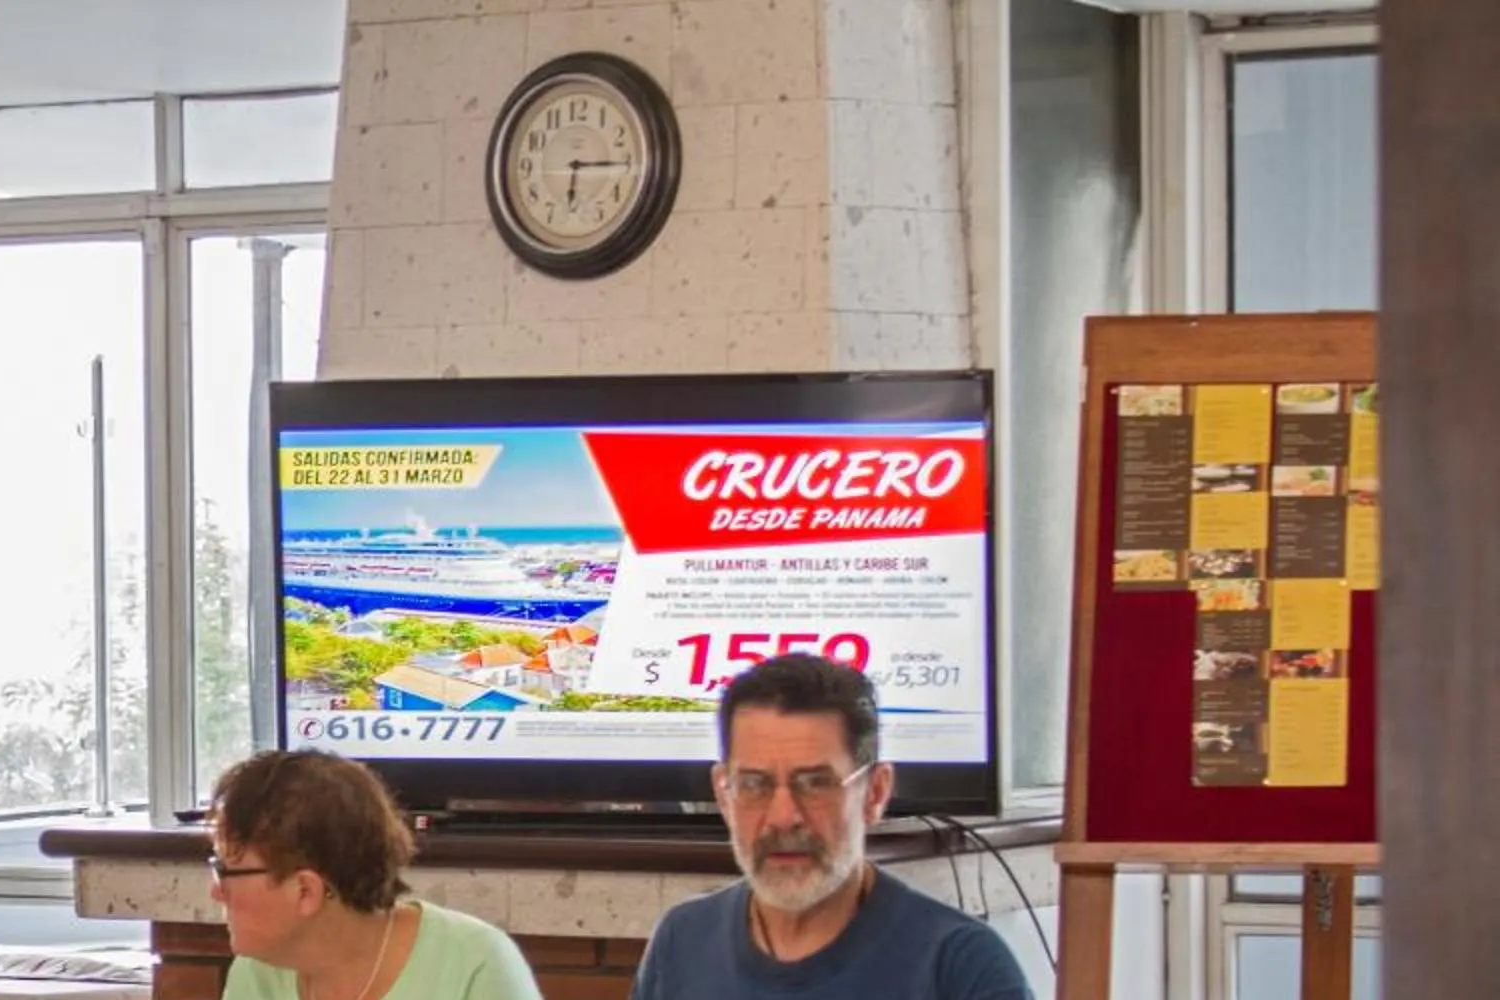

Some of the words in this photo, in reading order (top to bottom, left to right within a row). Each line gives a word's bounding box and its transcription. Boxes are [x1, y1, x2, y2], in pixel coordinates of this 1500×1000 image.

[546, 108, 560, 130] 11
[569, 99, 588, 122] 12
[529, 130, 546, 153] 10
[614, 126, 626, 148] 2
[520, 157, 533, 180] 9
[528, 182, 539, 204] 8
[611, 182, 620, 204] 4
[545, 200, 556, 225] 7
[595, 200, 606, 222] 5
[292, 450, 362, 467] SALIDAS
[293, 470, 323, 485] DEL
[329, 469, 349, 485] 22
[354, 469, 374, 485] AL
[379, 469, 399, 485] 31
[405, 468, 463, 485] MARZO
[682, 450, 966, 500] CRUCERO
[709, 508, 806, 532] DESDE
[810, 507, 926, 530] PANAMA
[684, 558, 768, 572] PULLMANTUR
[779, 557, 839, 572] ANTILLAS
[843, 558, 850, 571] Y
[854, 557, 899, 571] CARIBE
[904, 556, 930, 571] SUR
[644, 661, 660, 685] $
